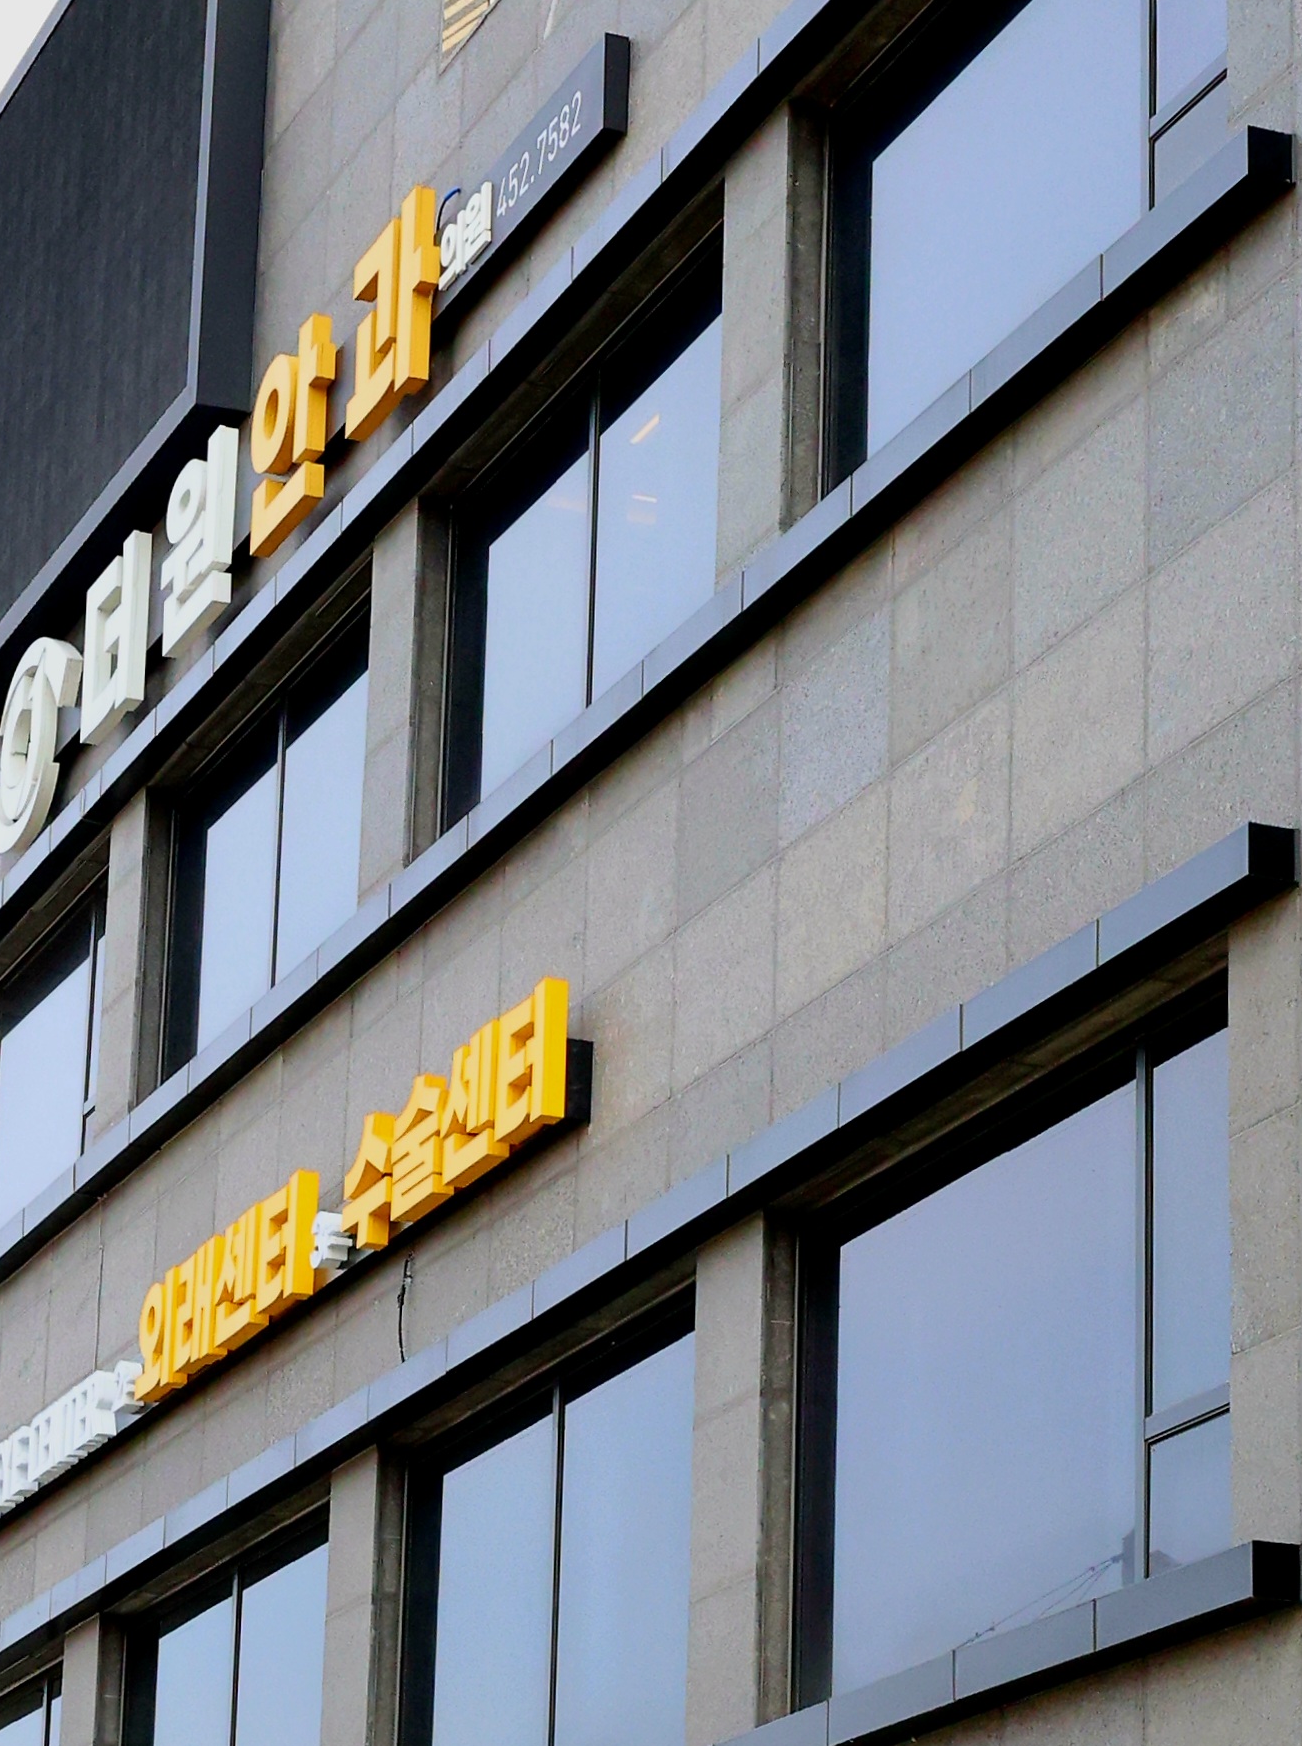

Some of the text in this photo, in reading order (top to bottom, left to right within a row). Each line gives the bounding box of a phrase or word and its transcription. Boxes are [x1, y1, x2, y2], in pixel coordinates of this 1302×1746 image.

[438, 181, 493, 291] 의원
[496, 90, 582, 218] 452.7582
[134, 1169, 320, 1403] 외래센터
[342, 977, 570, 1251] 수술센터
